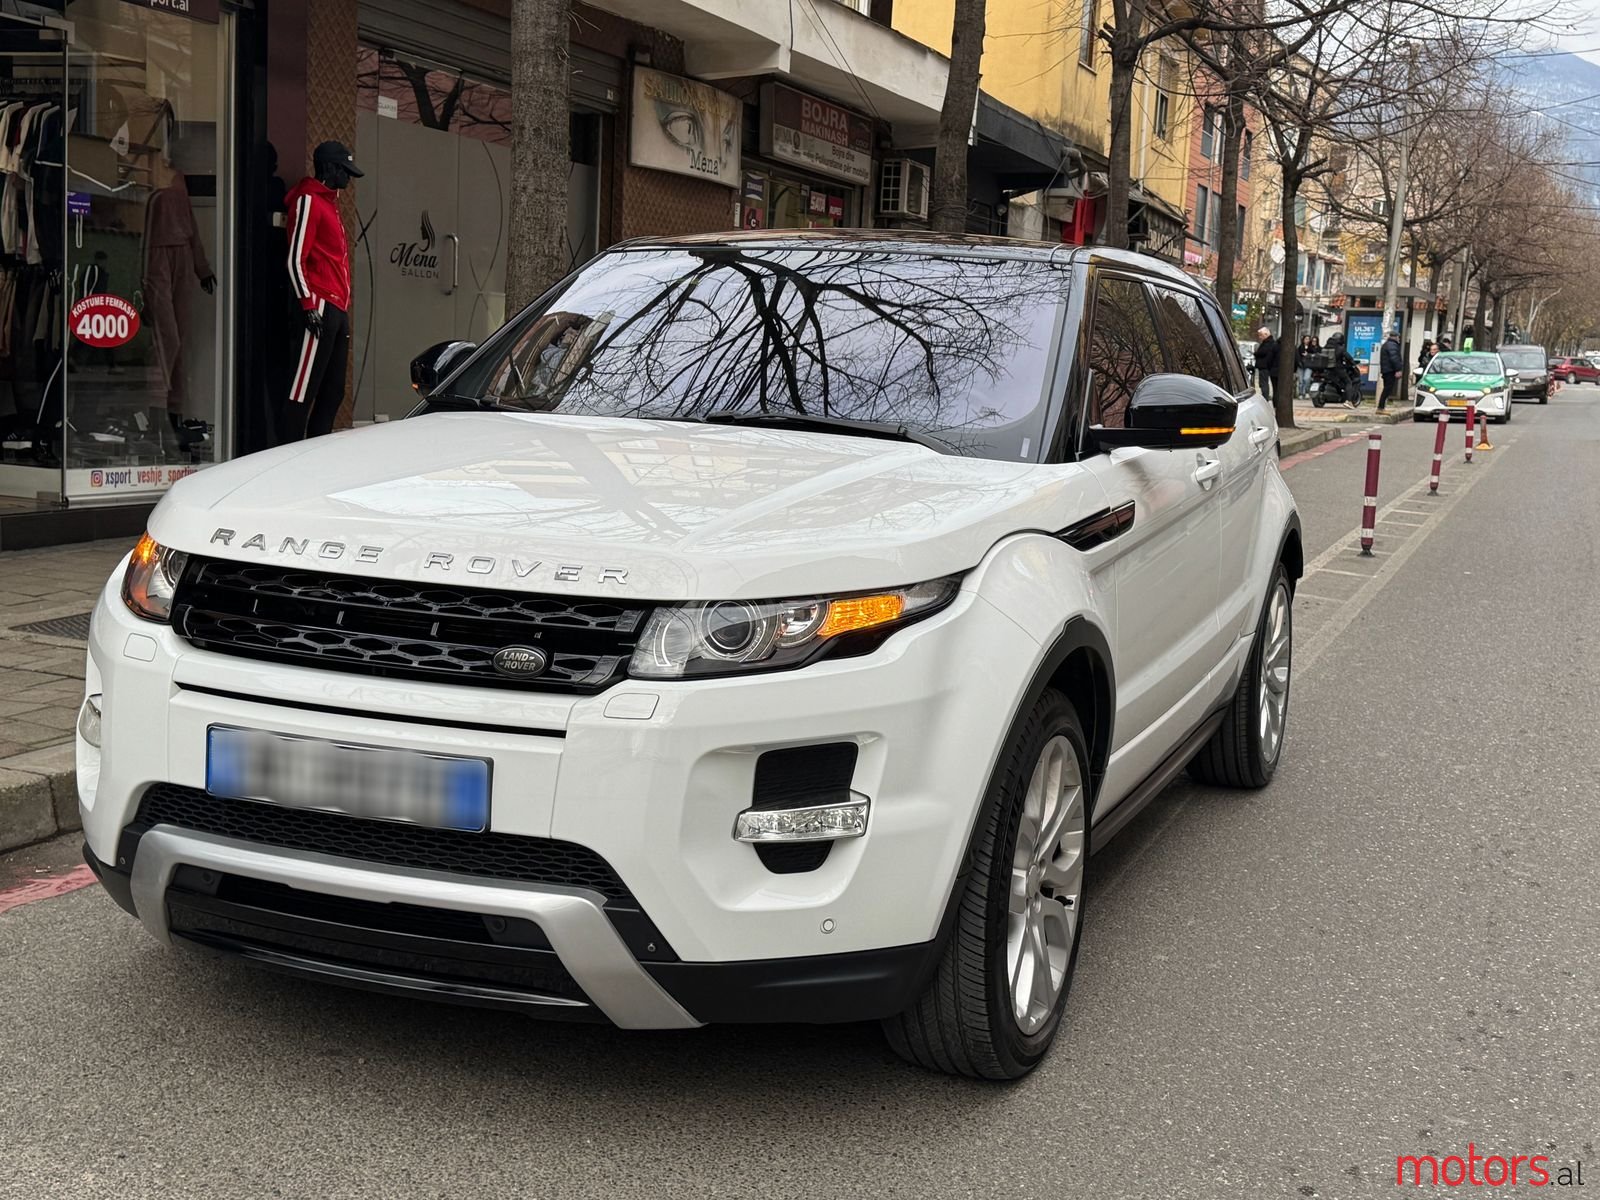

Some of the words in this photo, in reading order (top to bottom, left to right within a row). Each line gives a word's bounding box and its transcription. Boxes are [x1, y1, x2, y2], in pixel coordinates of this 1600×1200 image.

[801, 98, 849, 133] BOJRA
[801, 119, 849, 147] MAKINASH
[390, 242, 438, 268] Mena
[401, 267, 439, 279] SALLON
[71, 296, 104, 318] KOSTUME
[105, 296, 137, 320] FEMRASH
[76, 313, 129, 339] 4000
[210, 527, 384, 564] RANGE
[423, 551, 630, 585] ROVER
[502, 651, 529, 662] LAND
[503, 660, 536, 671] ROVER
